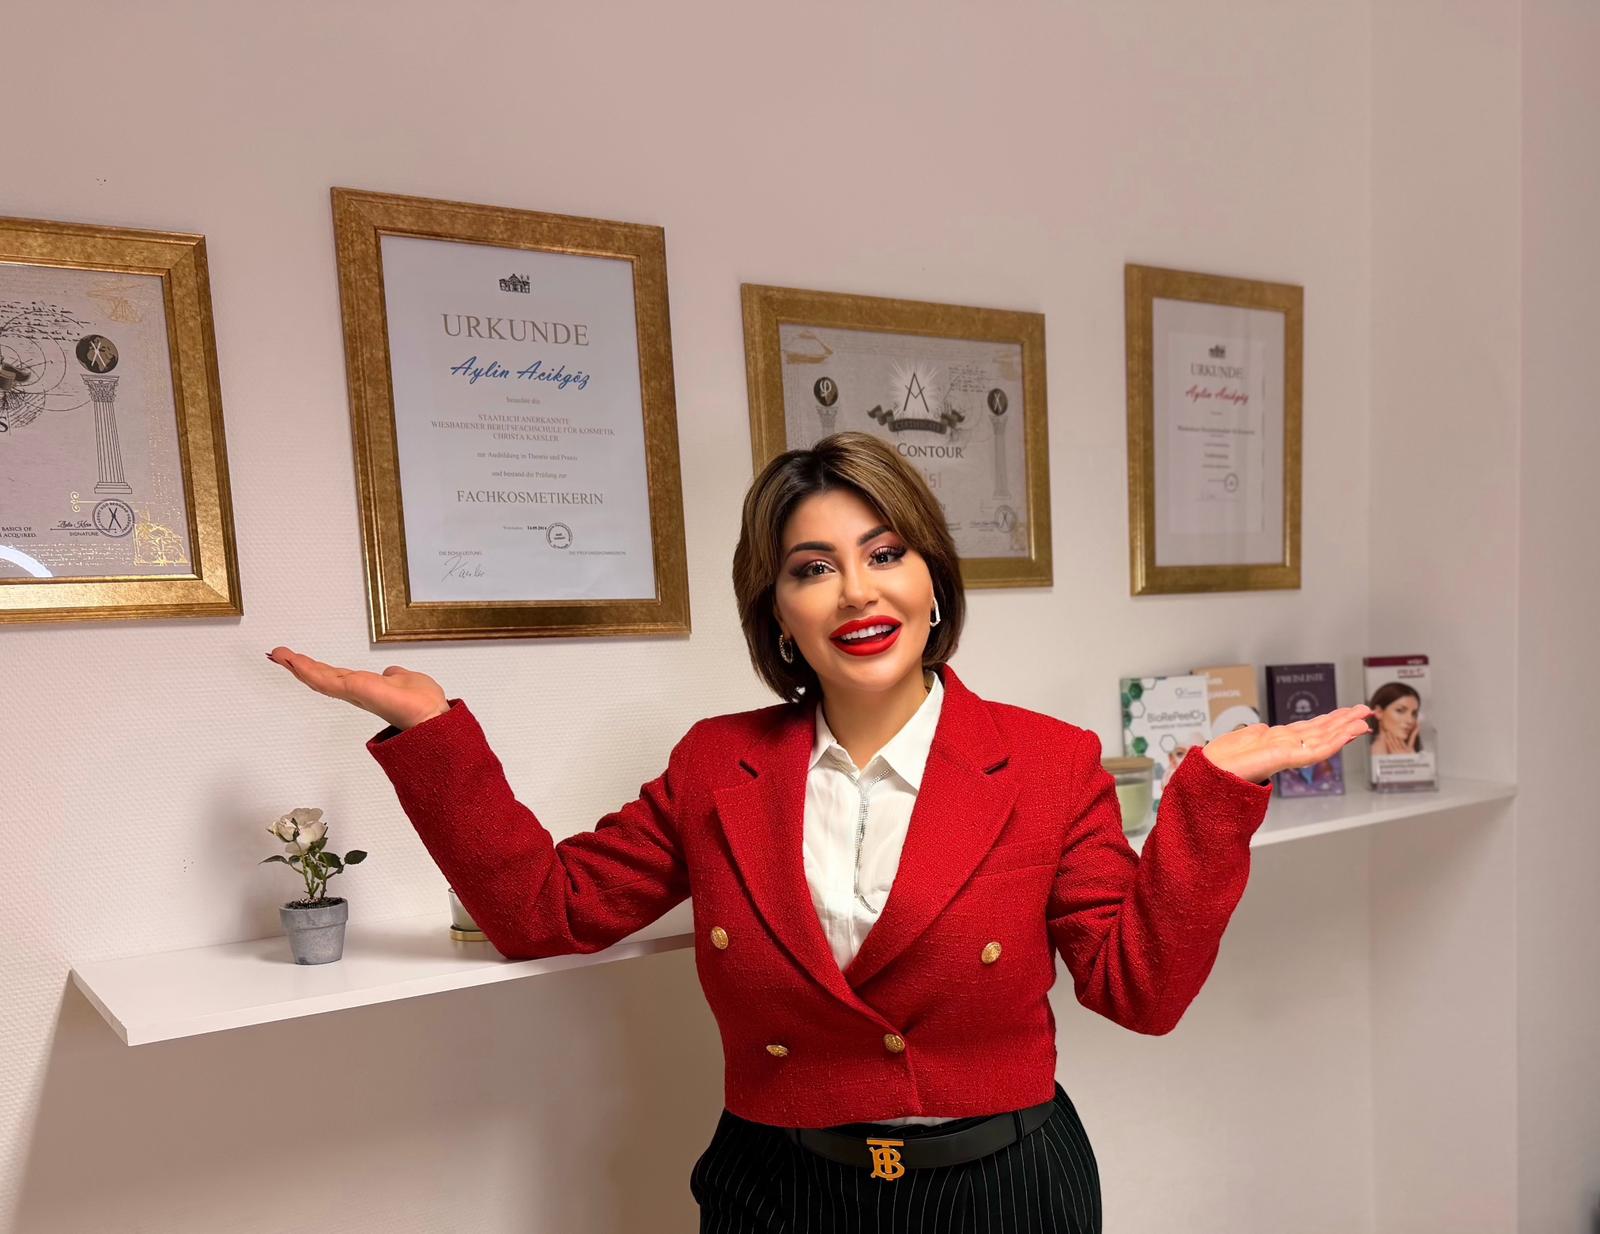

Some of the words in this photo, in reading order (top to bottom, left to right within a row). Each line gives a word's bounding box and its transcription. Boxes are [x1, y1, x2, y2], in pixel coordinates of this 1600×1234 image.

[441, 313, 590, 347] URKUNDE
[450, 356, 510, 385] Aylin
[457, 490, 604, 505] FACHKOSMETIKERIN
